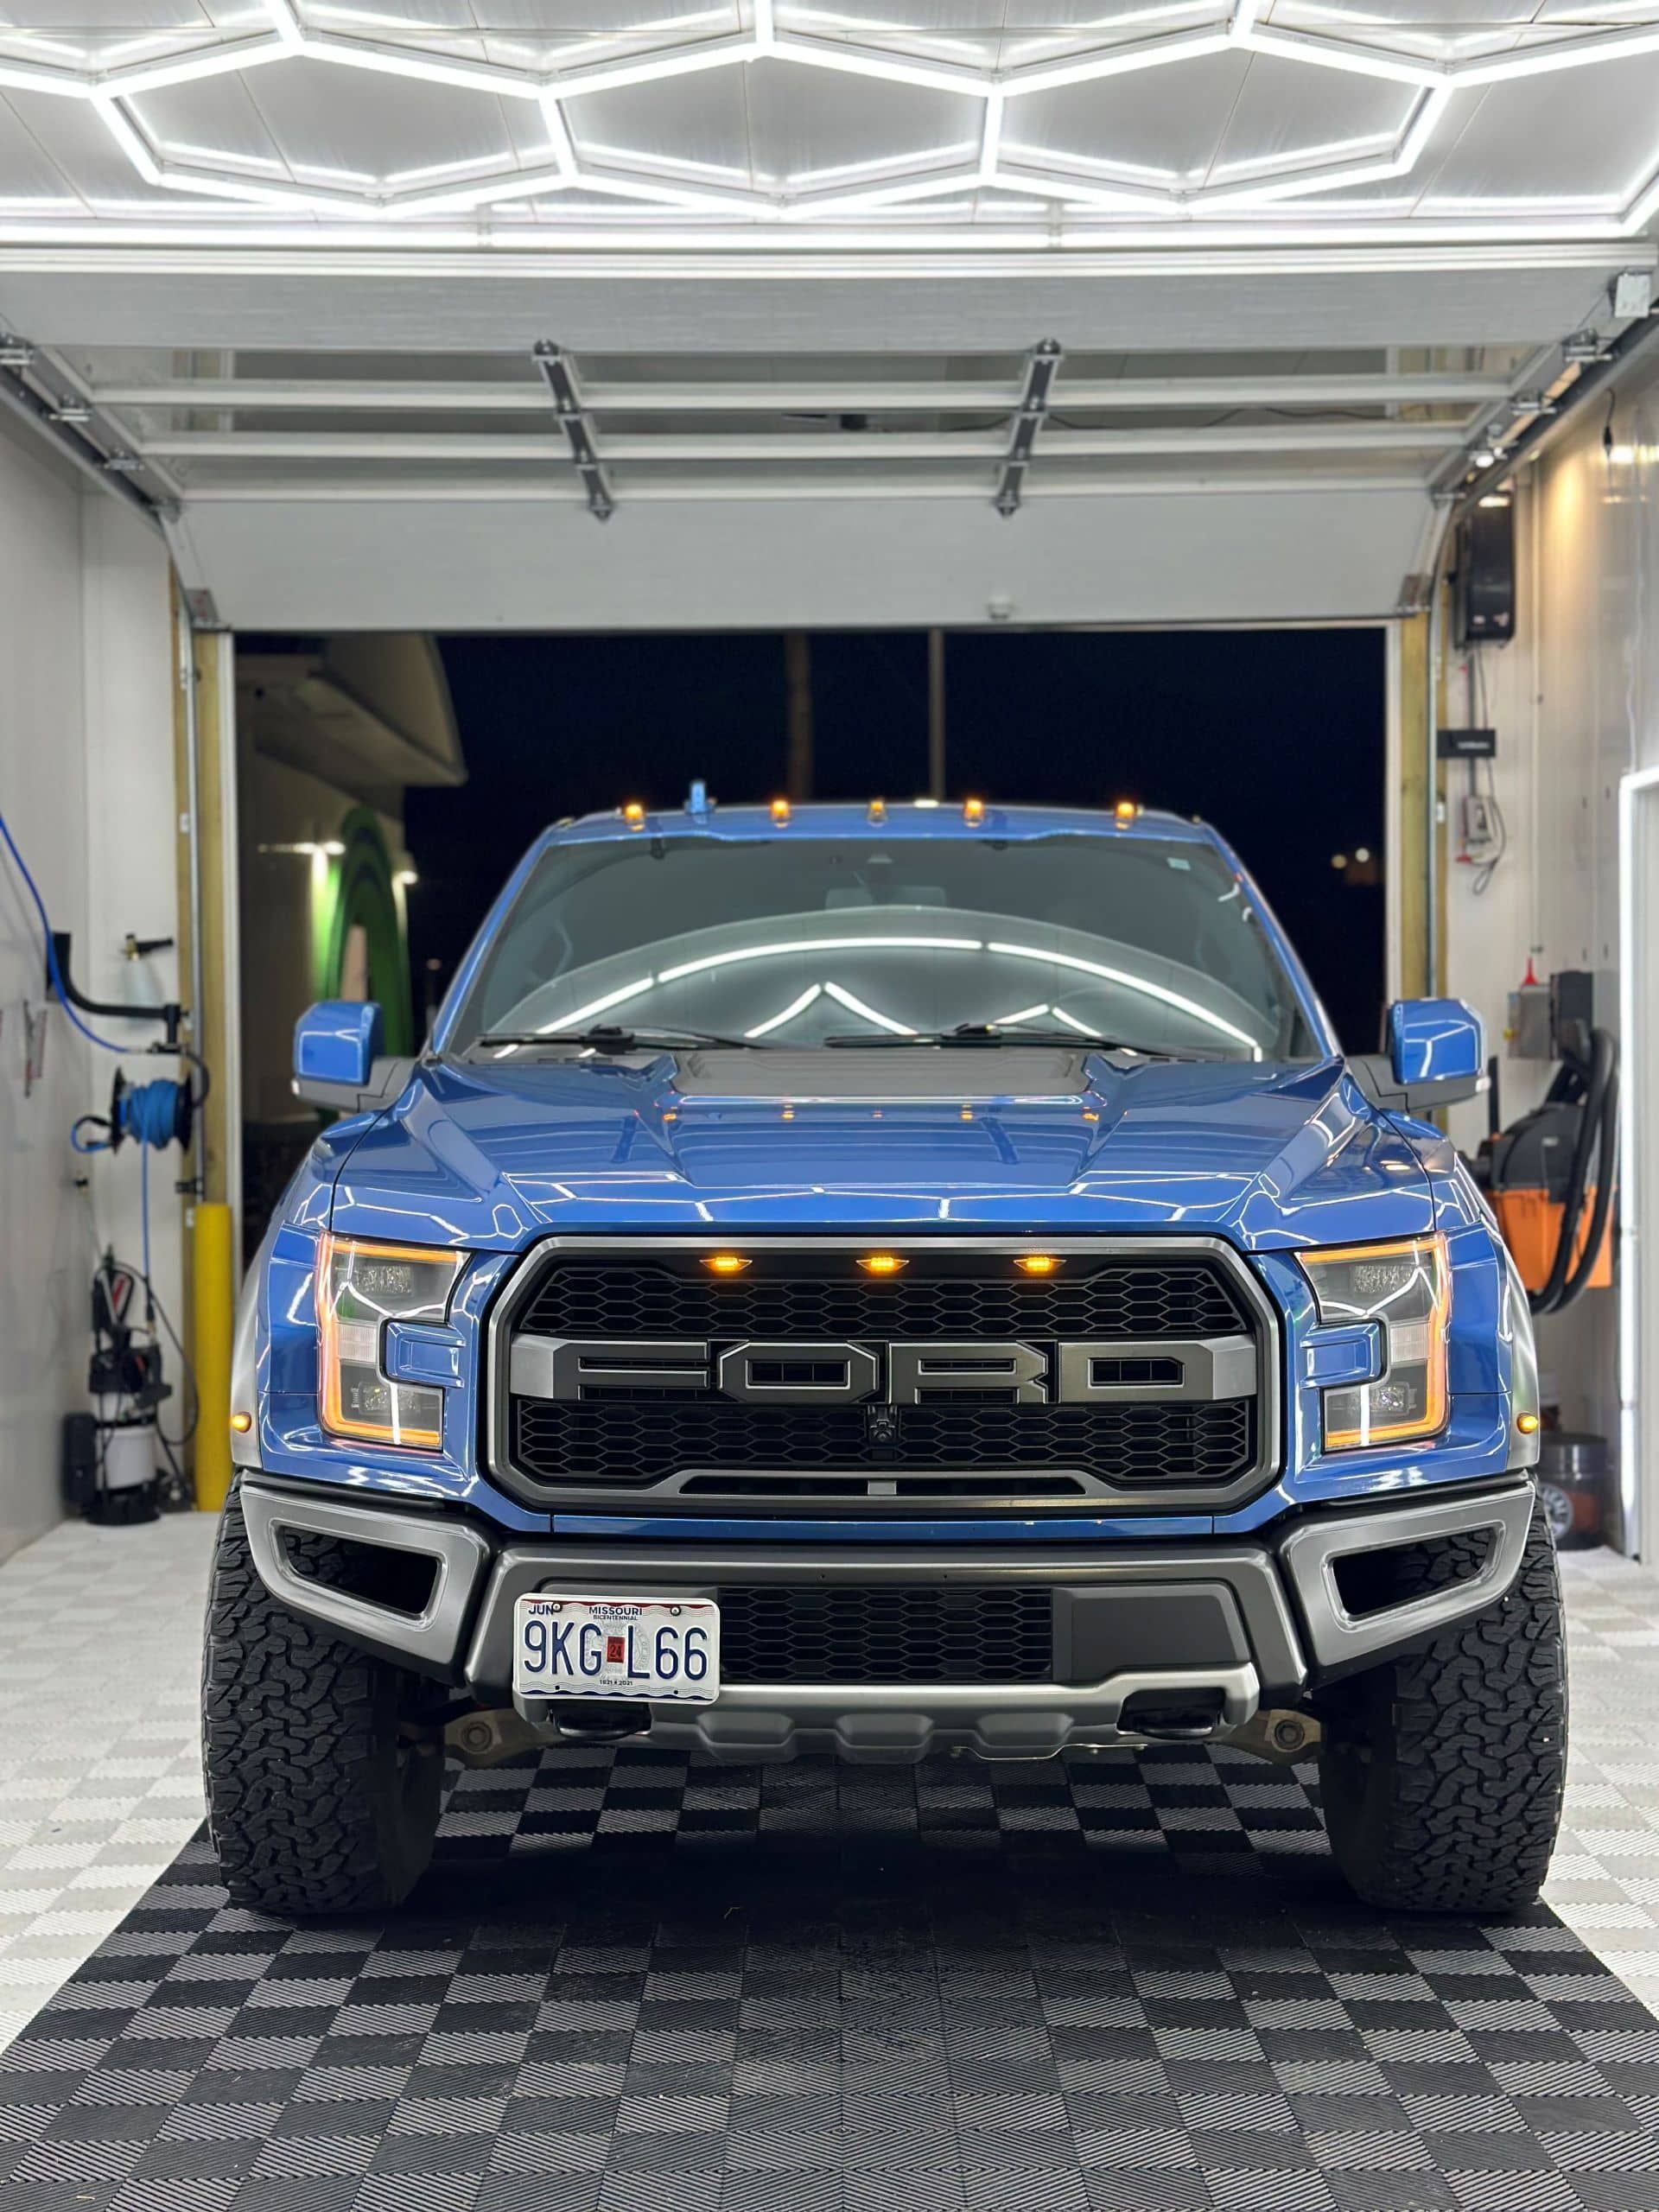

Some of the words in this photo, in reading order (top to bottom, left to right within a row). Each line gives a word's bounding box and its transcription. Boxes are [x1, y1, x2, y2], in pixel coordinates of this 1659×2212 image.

[551, 1338, 1213, 1405] FORD
[529, 1605, 554, 1615] JUN
[588, 1606, 643, 1616] MISSOURI
[524, 1620, 602, 1676] 9KG
[627, 1624, 708, 1681] L66
[609, 1645, 621, 1658] 24
